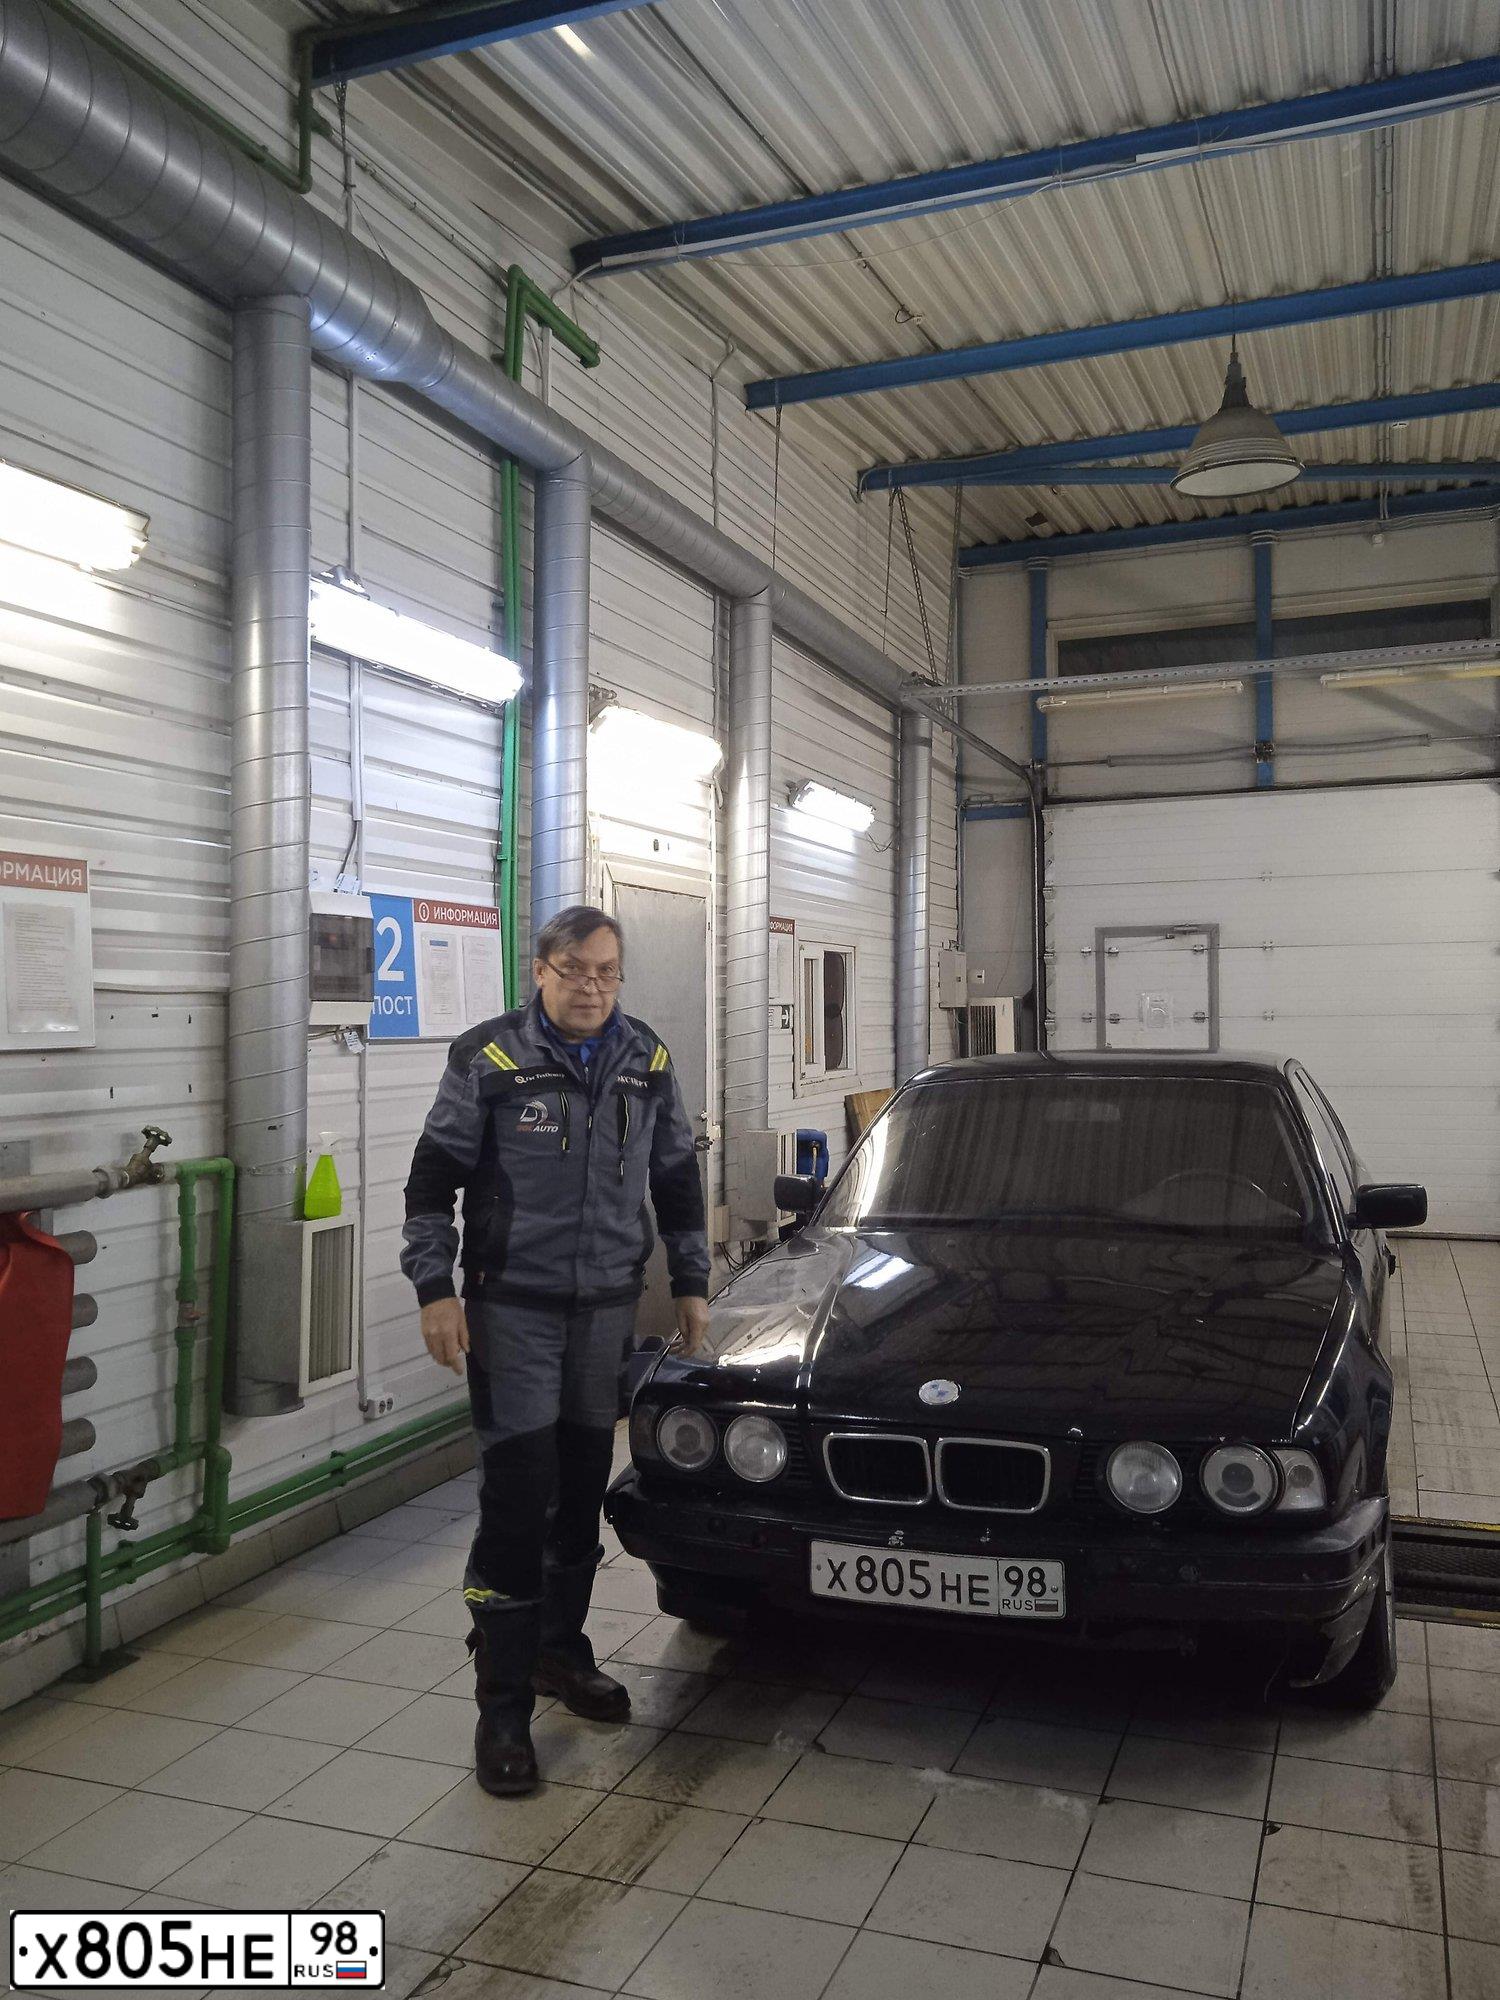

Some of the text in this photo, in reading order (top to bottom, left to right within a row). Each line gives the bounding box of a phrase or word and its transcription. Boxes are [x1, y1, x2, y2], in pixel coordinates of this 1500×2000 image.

[0, 861, 82, 887] РМАЦИЯ
[433, 906, 498, 926] ИНФОРМАЦИЯ
[376, 916, 405, 982] 2
[373, 995, 413, 1015] ПОСТ
[1003, 1565, 1047, 1598] 98
[1002, 1598, 1034, 1611] RUS
